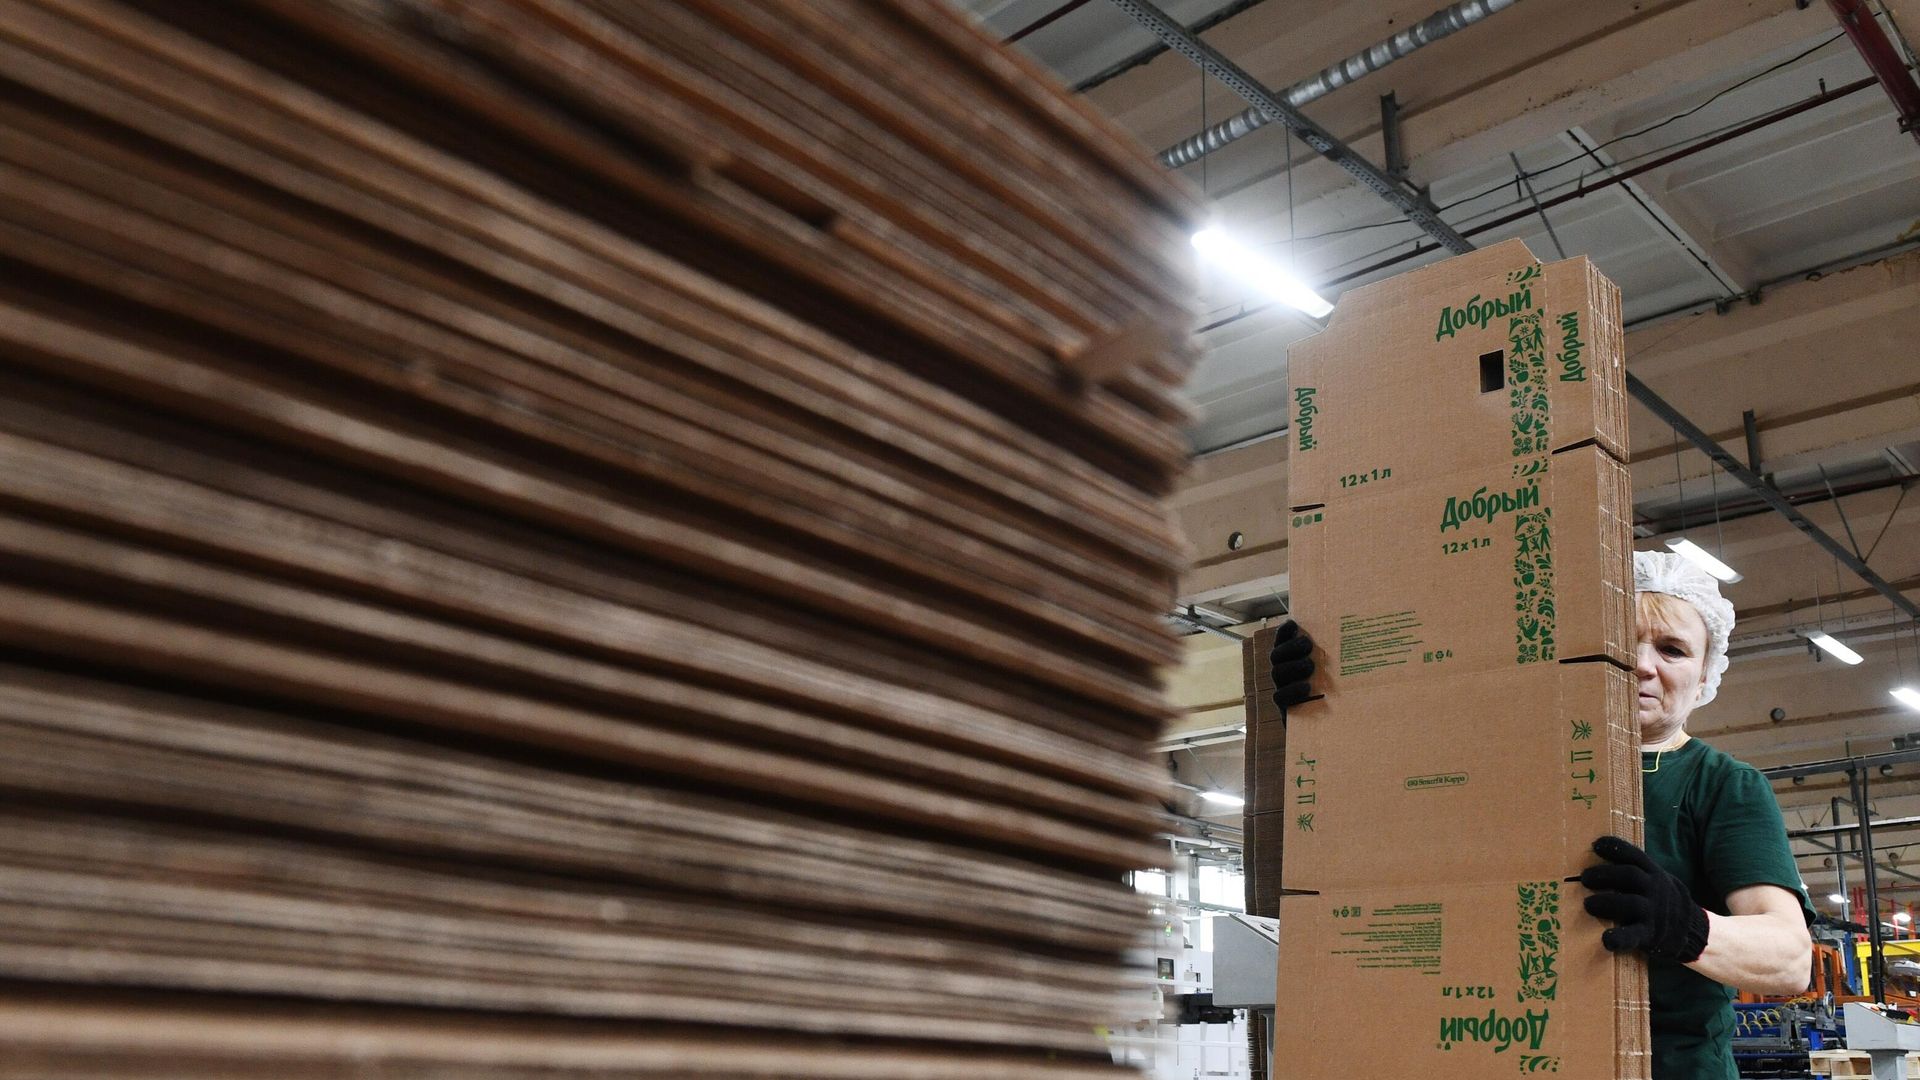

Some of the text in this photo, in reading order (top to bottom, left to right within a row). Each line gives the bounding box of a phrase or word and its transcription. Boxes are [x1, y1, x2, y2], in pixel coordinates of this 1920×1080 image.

[1436, 284, 1531, 342] Добрый
[1556, 312, 1586, 382] Добрый
[1295, 388, 1318, 451] Добрый
[1440, 479, 1539, 533] Добрый
[1440, 1009, 1549, 1053] Добрый
